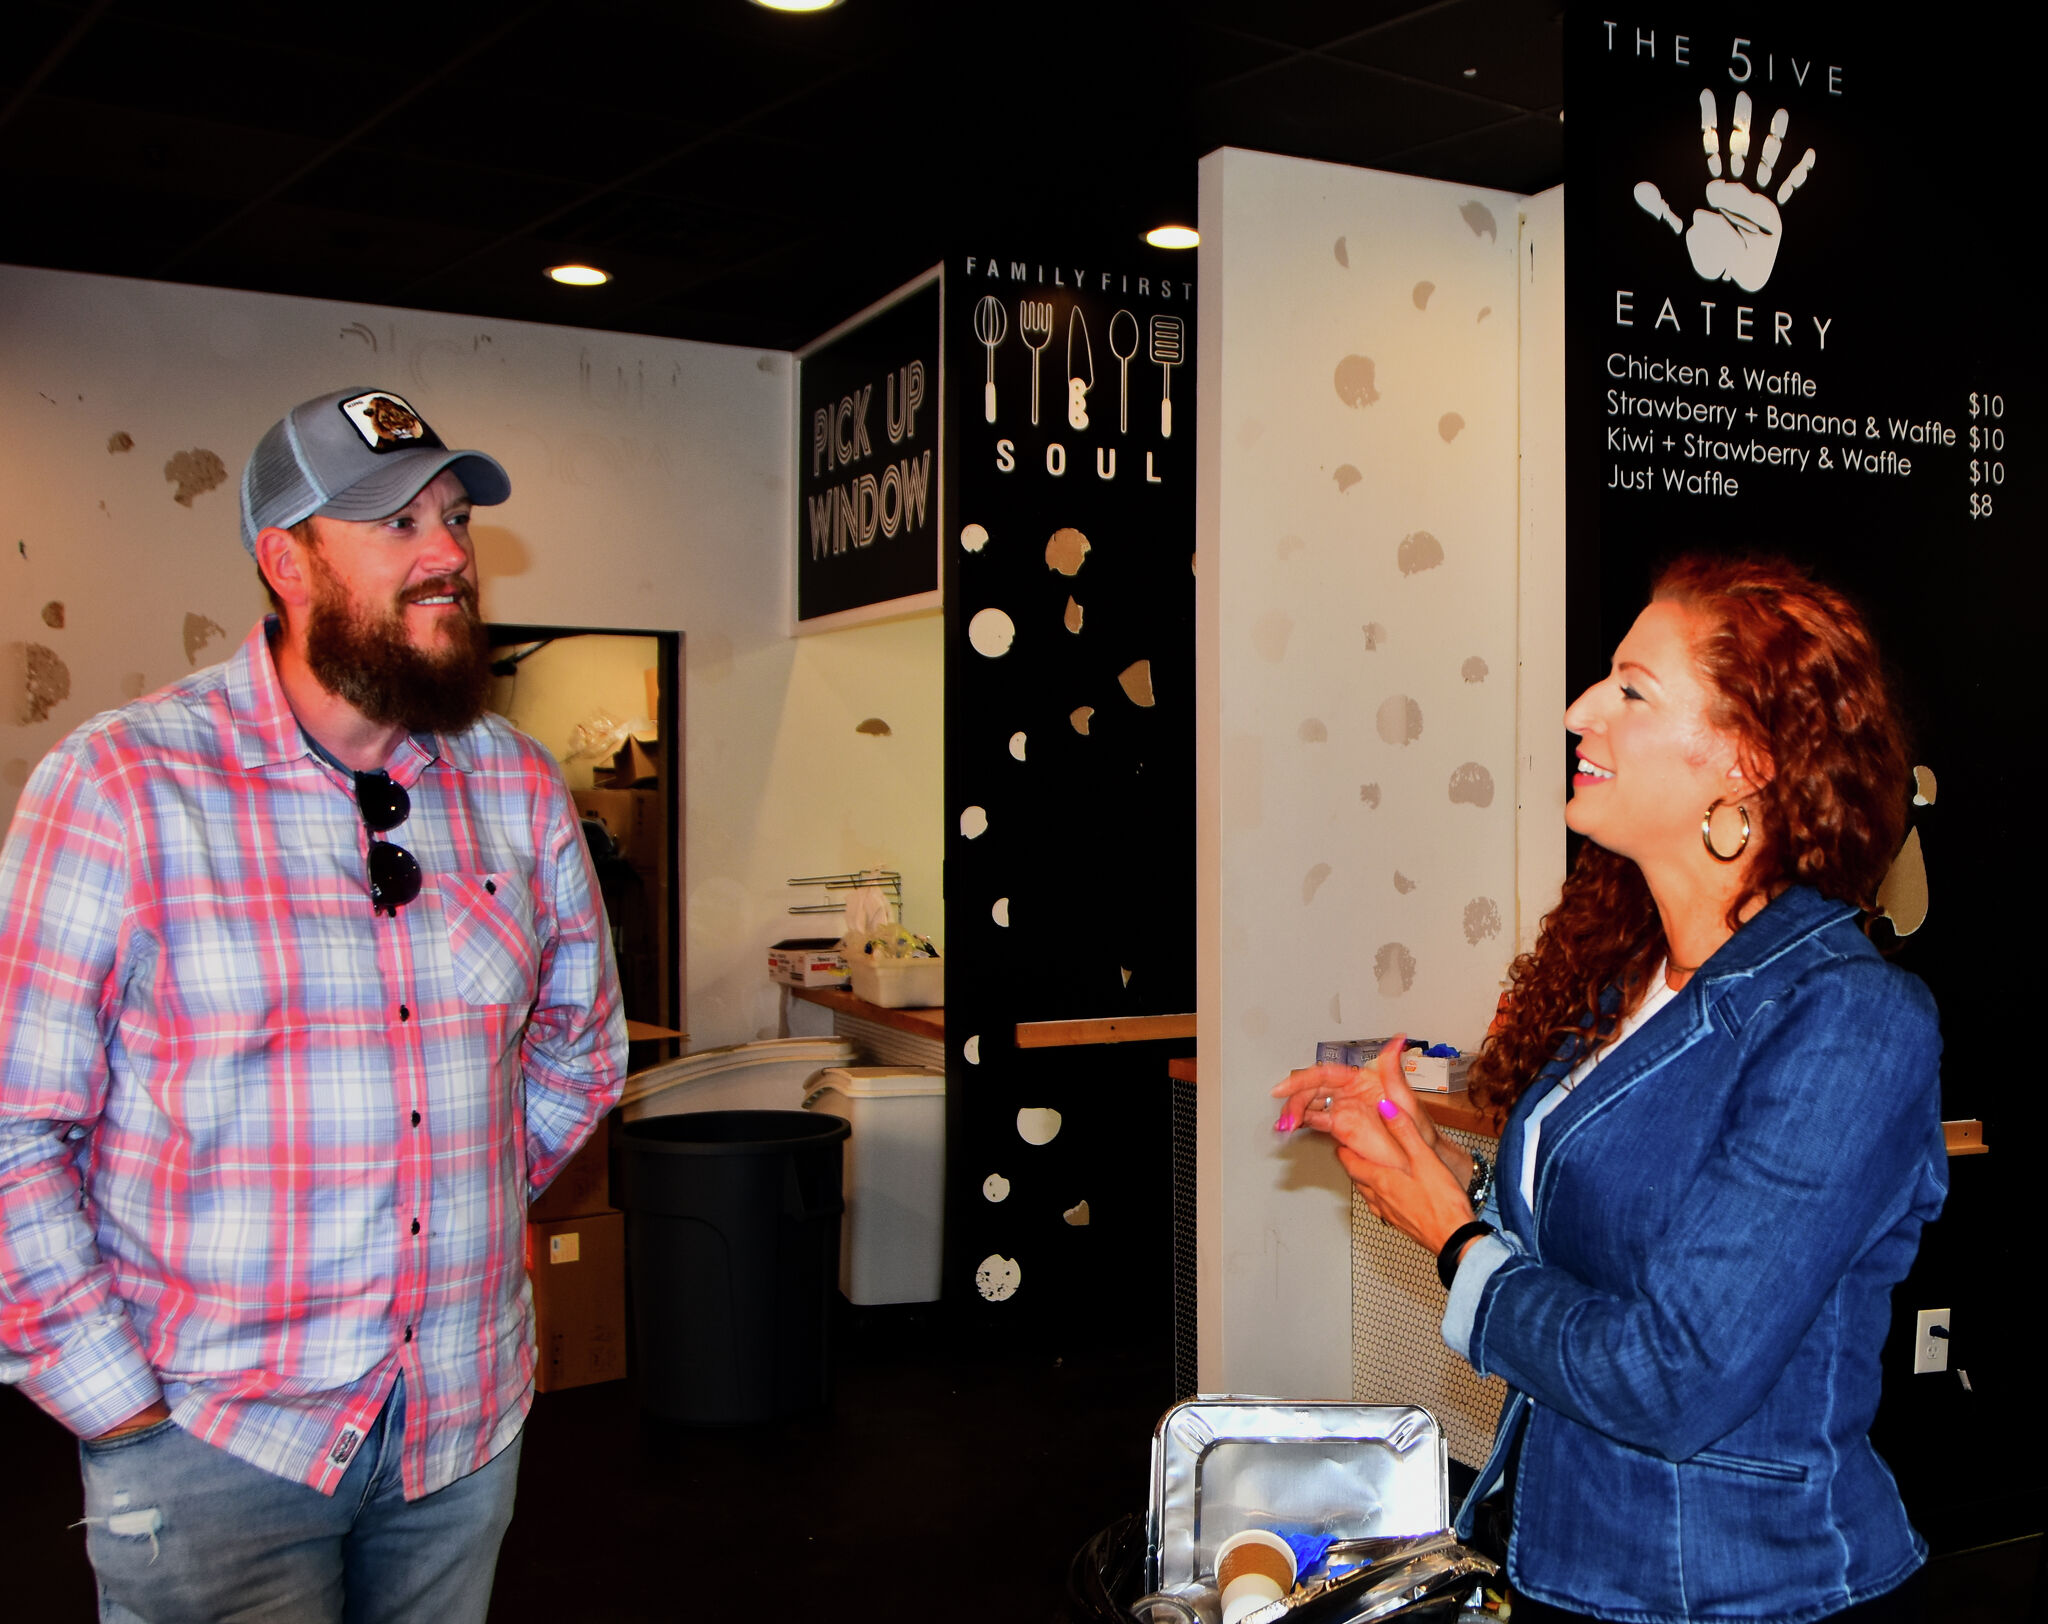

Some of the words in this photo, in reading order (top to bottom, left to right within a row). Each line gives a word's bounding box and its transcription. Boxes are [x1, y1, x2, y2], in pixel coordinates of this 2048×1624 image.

[1603, 20, 1690, 65] THE
[1728, 37, 1842, 95] 5IVE
[965, 256, 1086, 288] FAMILY
[1101, 272, 1192, 301] FIRST
[1616, 289, 1833, 350] EATERY
[1606, 352, 1709, 387] Chicken
[1718, 365, 1735, 390] &
[1743, 367, 1817, 398] Waffle
[812, 383, 873, 478] PICK
[886, 359, 926, 444] UP
[1606, 388, 1738, 431] Strawberry
[1744, 406, 1759, 424] +
[1766, 404, 1857, 437] Banana
[1864, 415, 1881, 439] &
[1888, 417, 1957, 447] Waffle
[1968, 391, 2004, 420] $10
[996, 438, 1163, 483] SOUL
[1607, 426, 1654, 454] Kiwi
[1661, 435, 1676, 452] +
[1683, 432, 1811, 473] Strawberry
[1817, 446, 1834, 469] &
[1841, 447, 1912, 476] Waffle
[1969, 424, 2005, 453] $10
[1607, 463, 1655, 491] Just
[1662, 467, 1739, 497] Waffle
[1969, 458, 2005, 487] $10
[808, 449, 931, 561] WINDOW
[1969, 491, 1993, 520] $8
